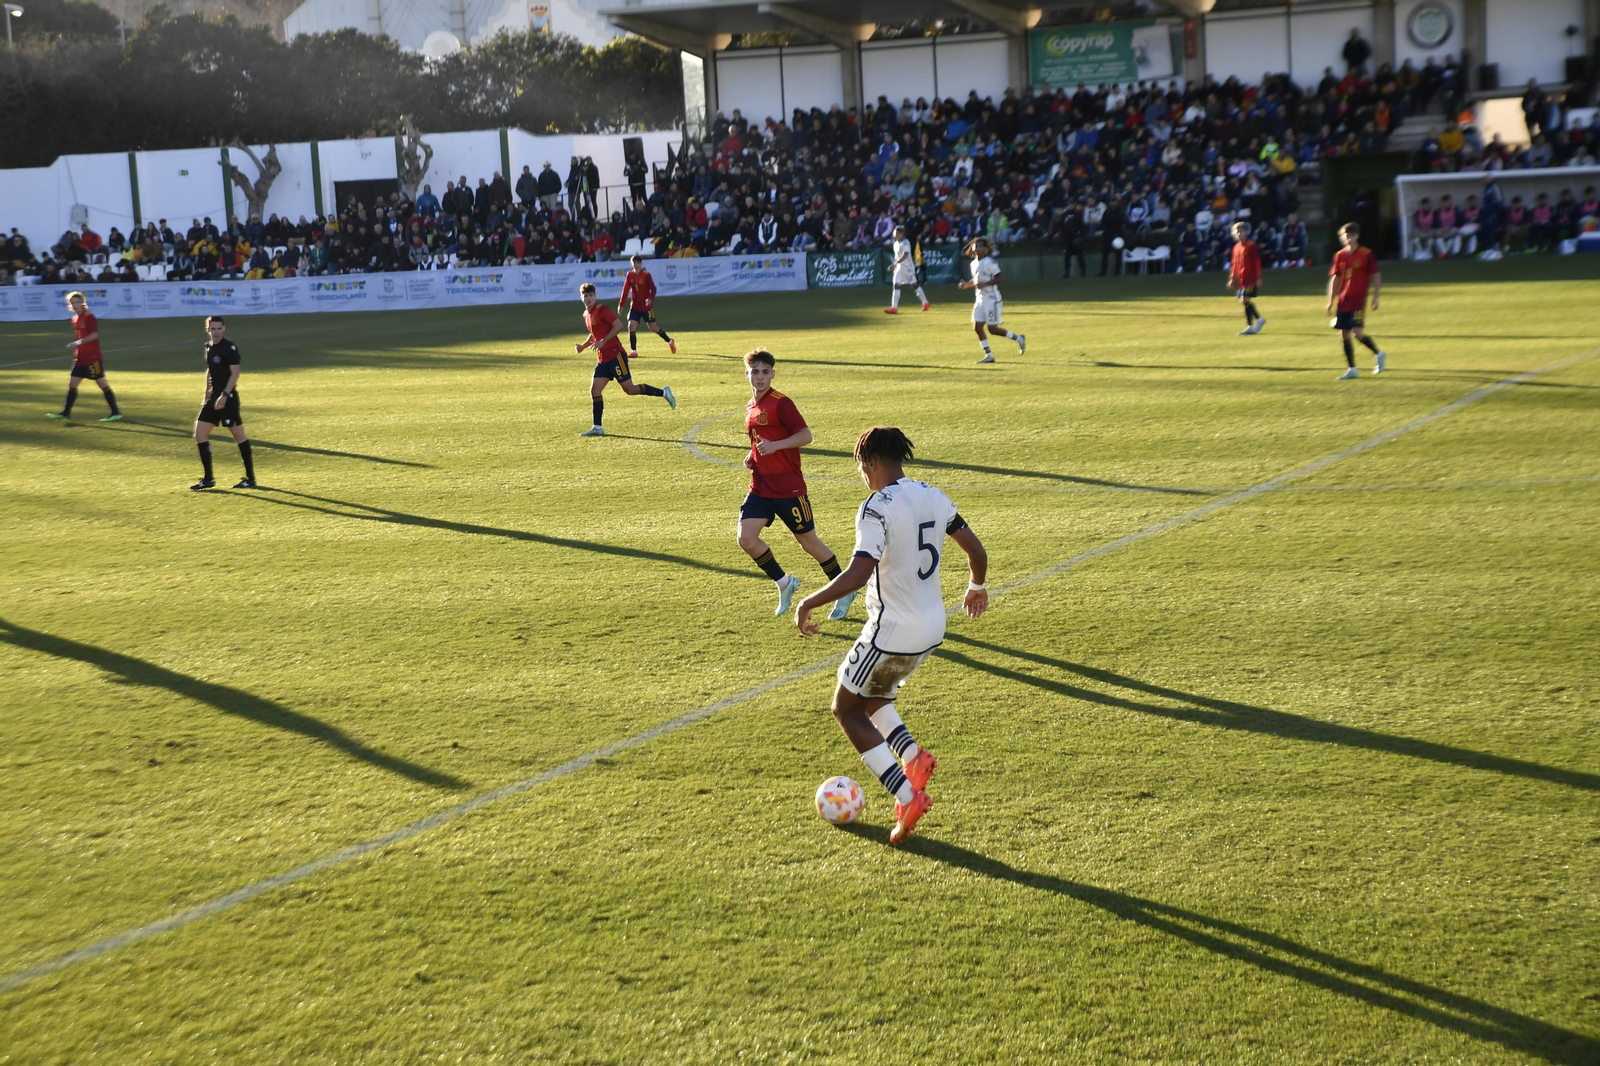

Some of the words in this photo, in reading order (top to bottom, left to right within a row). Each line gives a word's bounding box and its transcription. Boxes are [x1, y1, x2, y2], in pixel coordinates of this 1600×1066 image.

[843, 253, 871, 262] FRUTAS
[732, 271, 796, 280] TORREMOLINOS
[445, 286, 504, 294] TORREMOLINOS
[310, 293, 367, 301] TORREMOLINOS
[615, 365, 622, 376] 6
[791, 506, 803, 524] 9
[917, 520, 940, 581] 5
[849, 641, 865, 665] 5
